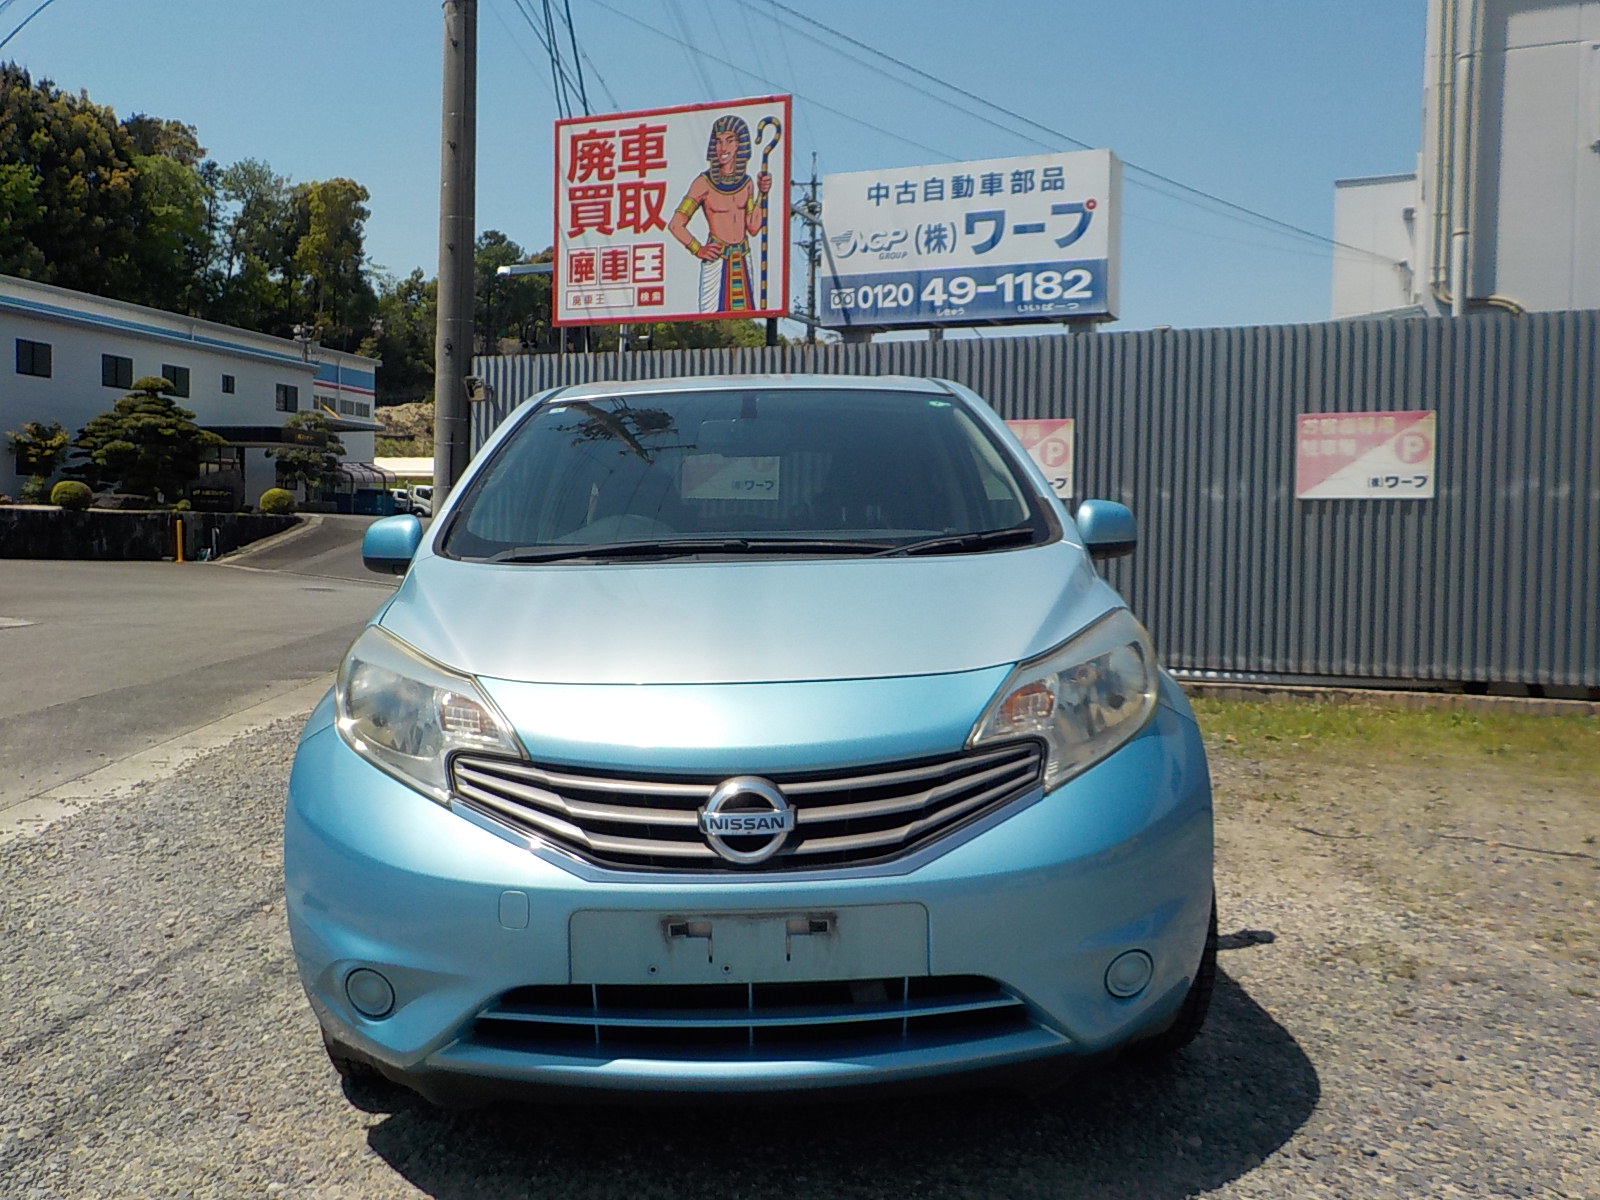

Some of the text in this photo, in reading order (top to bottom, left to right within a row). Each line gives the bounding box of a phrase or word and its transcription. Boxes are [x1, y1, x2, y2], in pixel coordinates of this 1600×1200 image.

[567, 123, 667, 184] 廃車
[867, 165, 1065, 206] 中古自動車部品
[567, 181, 667, 239] 買取
[568, 243, 664, 286] 廃車王
[878, 250, 908, 261] GROUP
[572, 292, 605, 306] 廃車王
[857, 268, 1093, 309] 0120 49-1182
[709, 816, 785, 831] NISSAN
